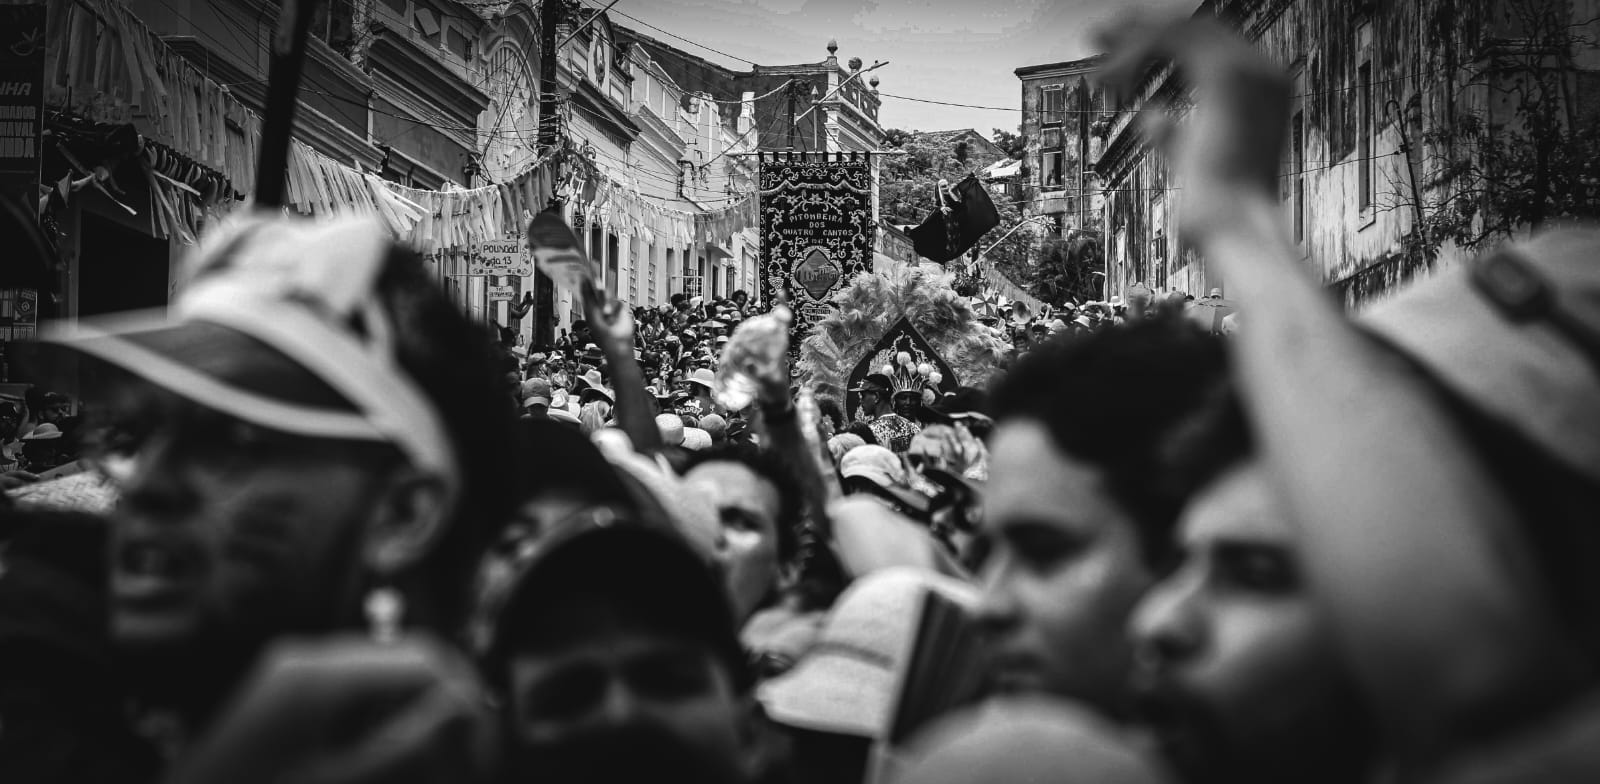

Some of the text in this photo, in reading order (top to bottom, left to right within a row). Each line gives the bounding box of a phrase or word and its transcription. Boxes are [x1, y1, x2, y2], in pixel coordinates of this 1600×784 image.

[789, 213, 843, 223] PITOMBEIRA
[782, 228, 814, 236] QUATRO
[502, 256, 512, 265] 13
